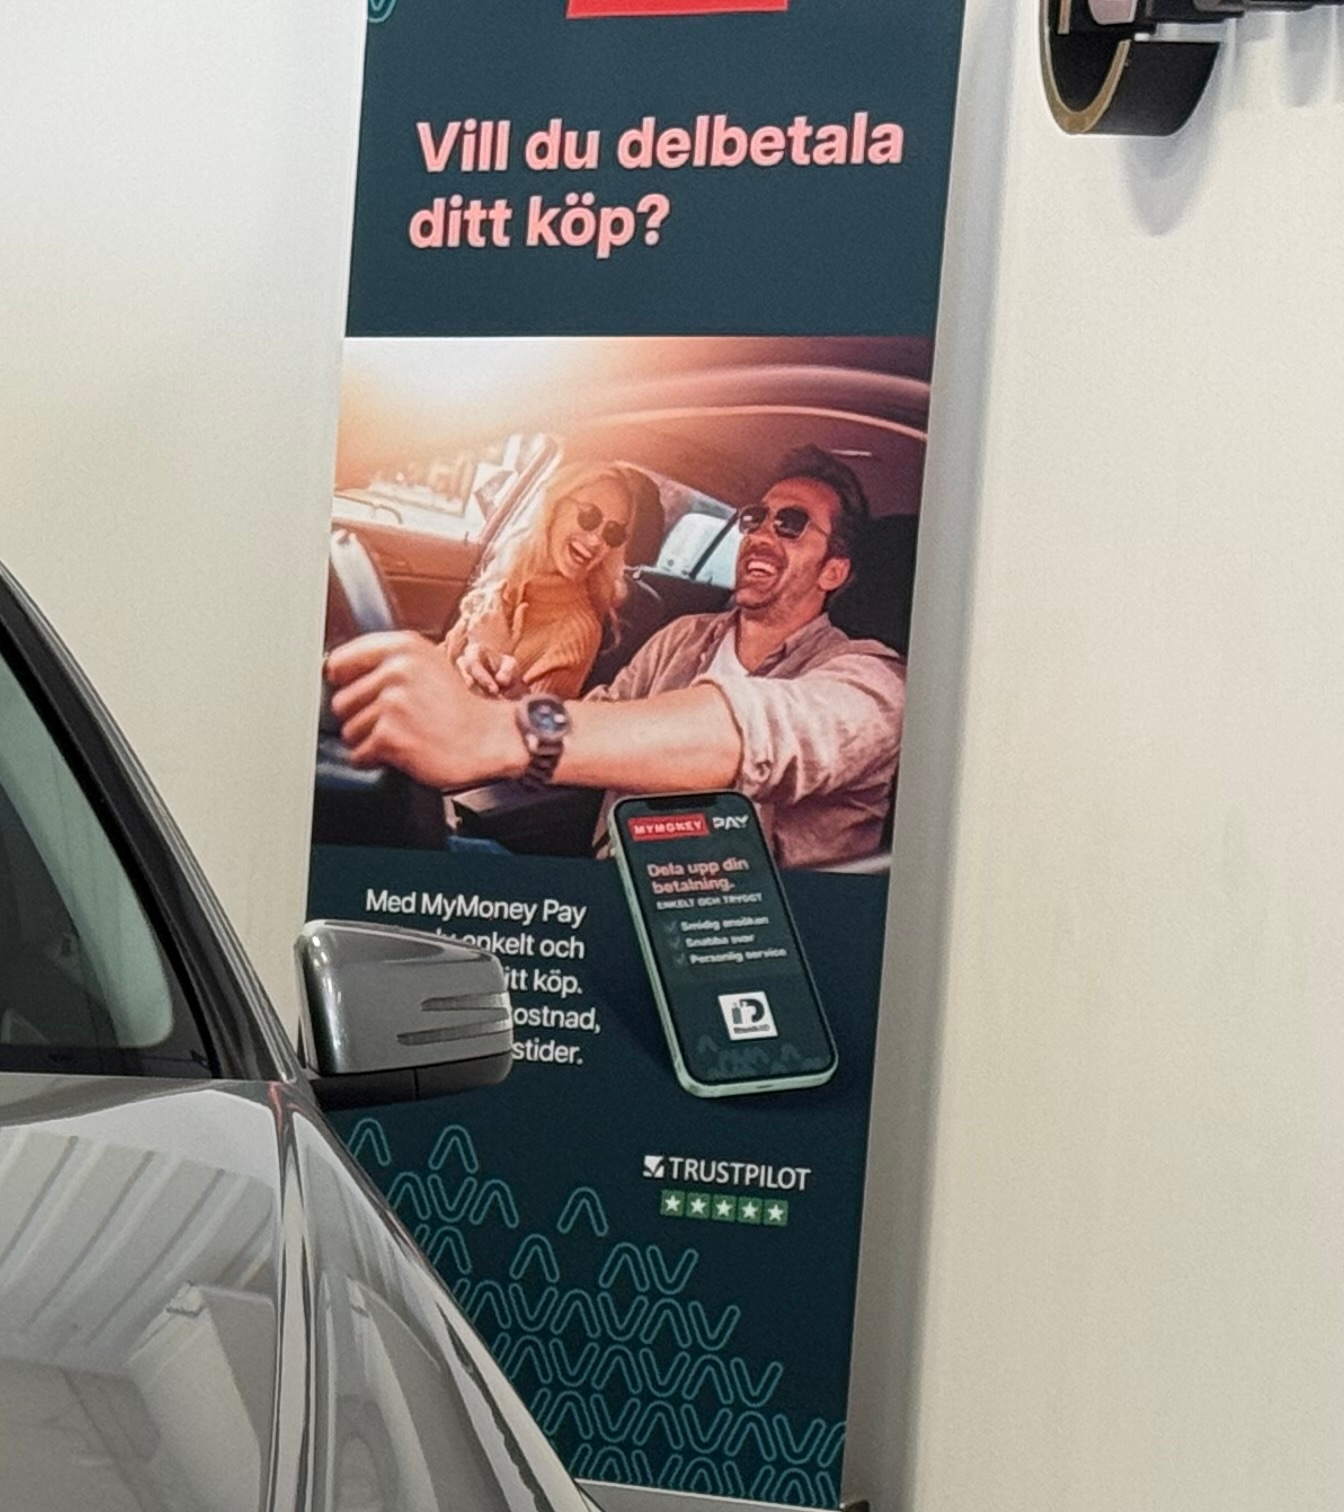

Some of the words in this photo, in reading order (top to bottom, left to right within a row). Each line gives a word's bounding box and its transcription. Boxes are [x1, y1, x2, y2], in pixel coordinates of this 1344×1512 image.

[417, 118, 510, 172] Vill
[524, 118, 600, 171] du
[616, 111, 905, 168] delbetala
[409, 194, 511, 248] ditt
[525, 191, 670, 259] köp?
[712, 814, 748, 830] PAY
[647, 861, 685, 878] Dela
[688, 861, 720, 876] upp
[722, 856, 750, 871] din
[652, 877, 735, 895] betalning.
[366, 889, 416, 913] Med
[421, 893, 538, 926] MyMoney
[542, 900, 587, 929] Pay
[540, 936, 585, 960] och
[533, 969, 583, 998] köp.
[513, 1006, 601, 1034] ostnad,
[512, 1038, 583, 1065] stider.
[669, 1157, 811, 1191] TRUSTPILOT
